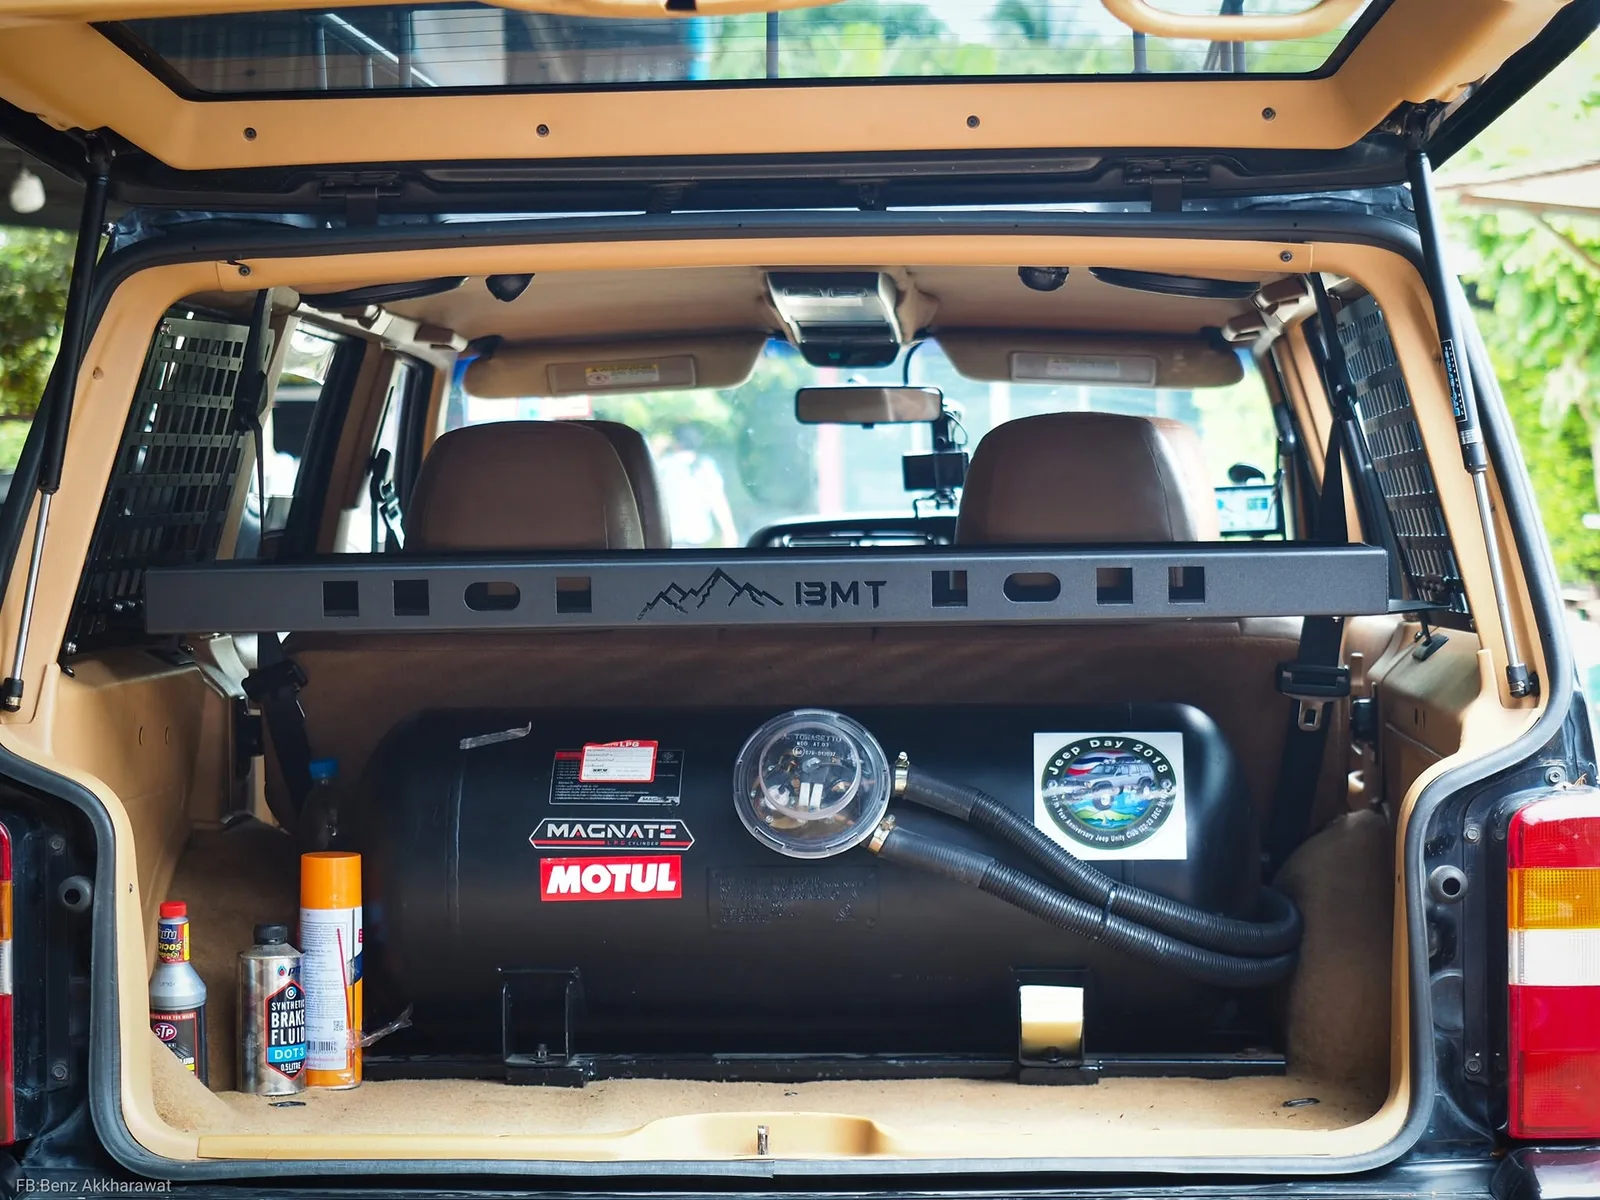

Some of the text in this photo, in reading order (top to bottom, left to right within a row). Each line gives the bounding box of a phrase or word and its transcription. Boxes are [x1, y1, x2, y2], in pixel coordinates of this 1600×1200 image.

[1048, 740, 1169, 775] Jeep Day 2018
[547, 823, 676, 839] MAGNATE
[1057, 807, 1068, 821] Year
[1065, 819, 1094, 841] Anniversary
[1095, 835, 1109, 843] Jeep
[1110, 834, 1125, 843] Unity
[1126, 828, 1139, 839] Club
[1151, 807, 1162, 820] DEC
[546, 863, 676, 894] MOTUL
[271, 1009, 305, 1028] BRAKE
[156, 1025, 174, 1038] STP
[271, 1026, 305, 1045] FLUID
